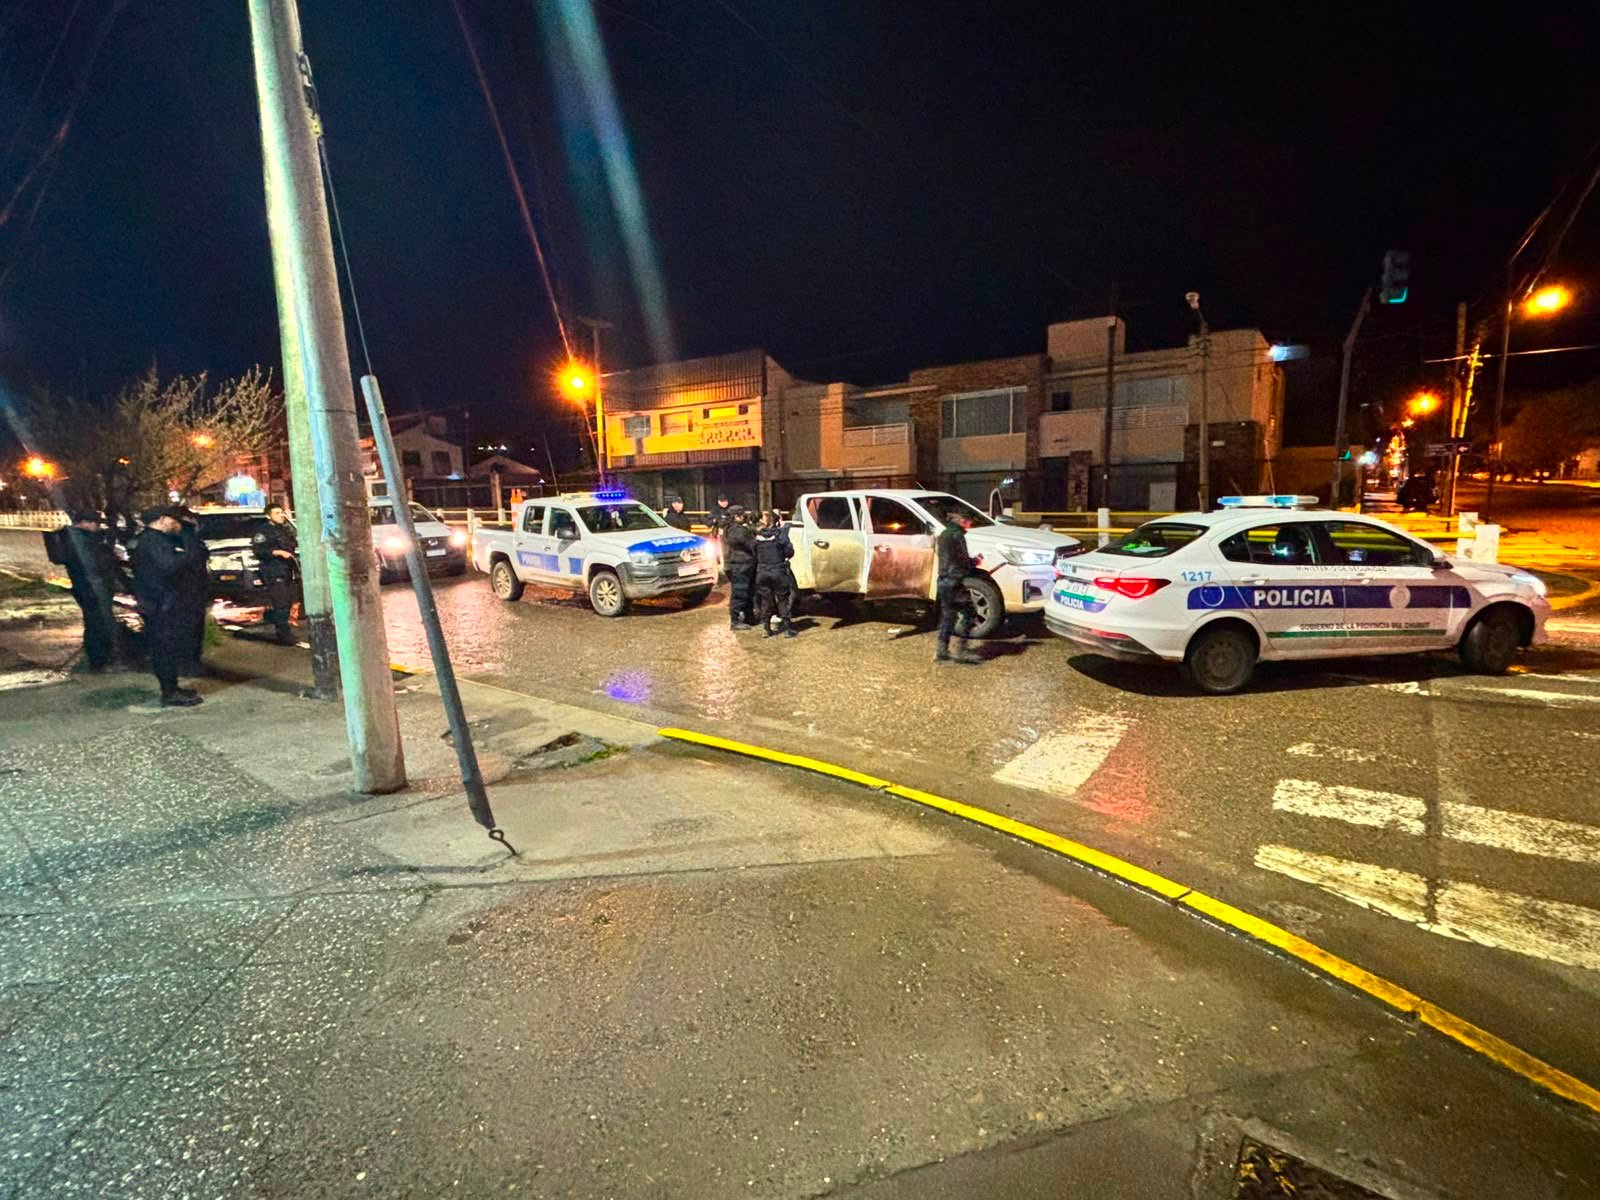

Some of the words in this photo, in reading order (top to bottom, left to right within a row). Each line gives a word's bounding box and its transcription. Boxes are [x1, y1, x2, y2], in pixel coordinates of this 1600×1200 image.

[1181, 571, 1212, 582] 1217
[1060, 595, 1085, 610] POLICIA
[1253, 589, 1335, 607] POLICIA
[1300, 623, 1334, 631] GOBIERNO
